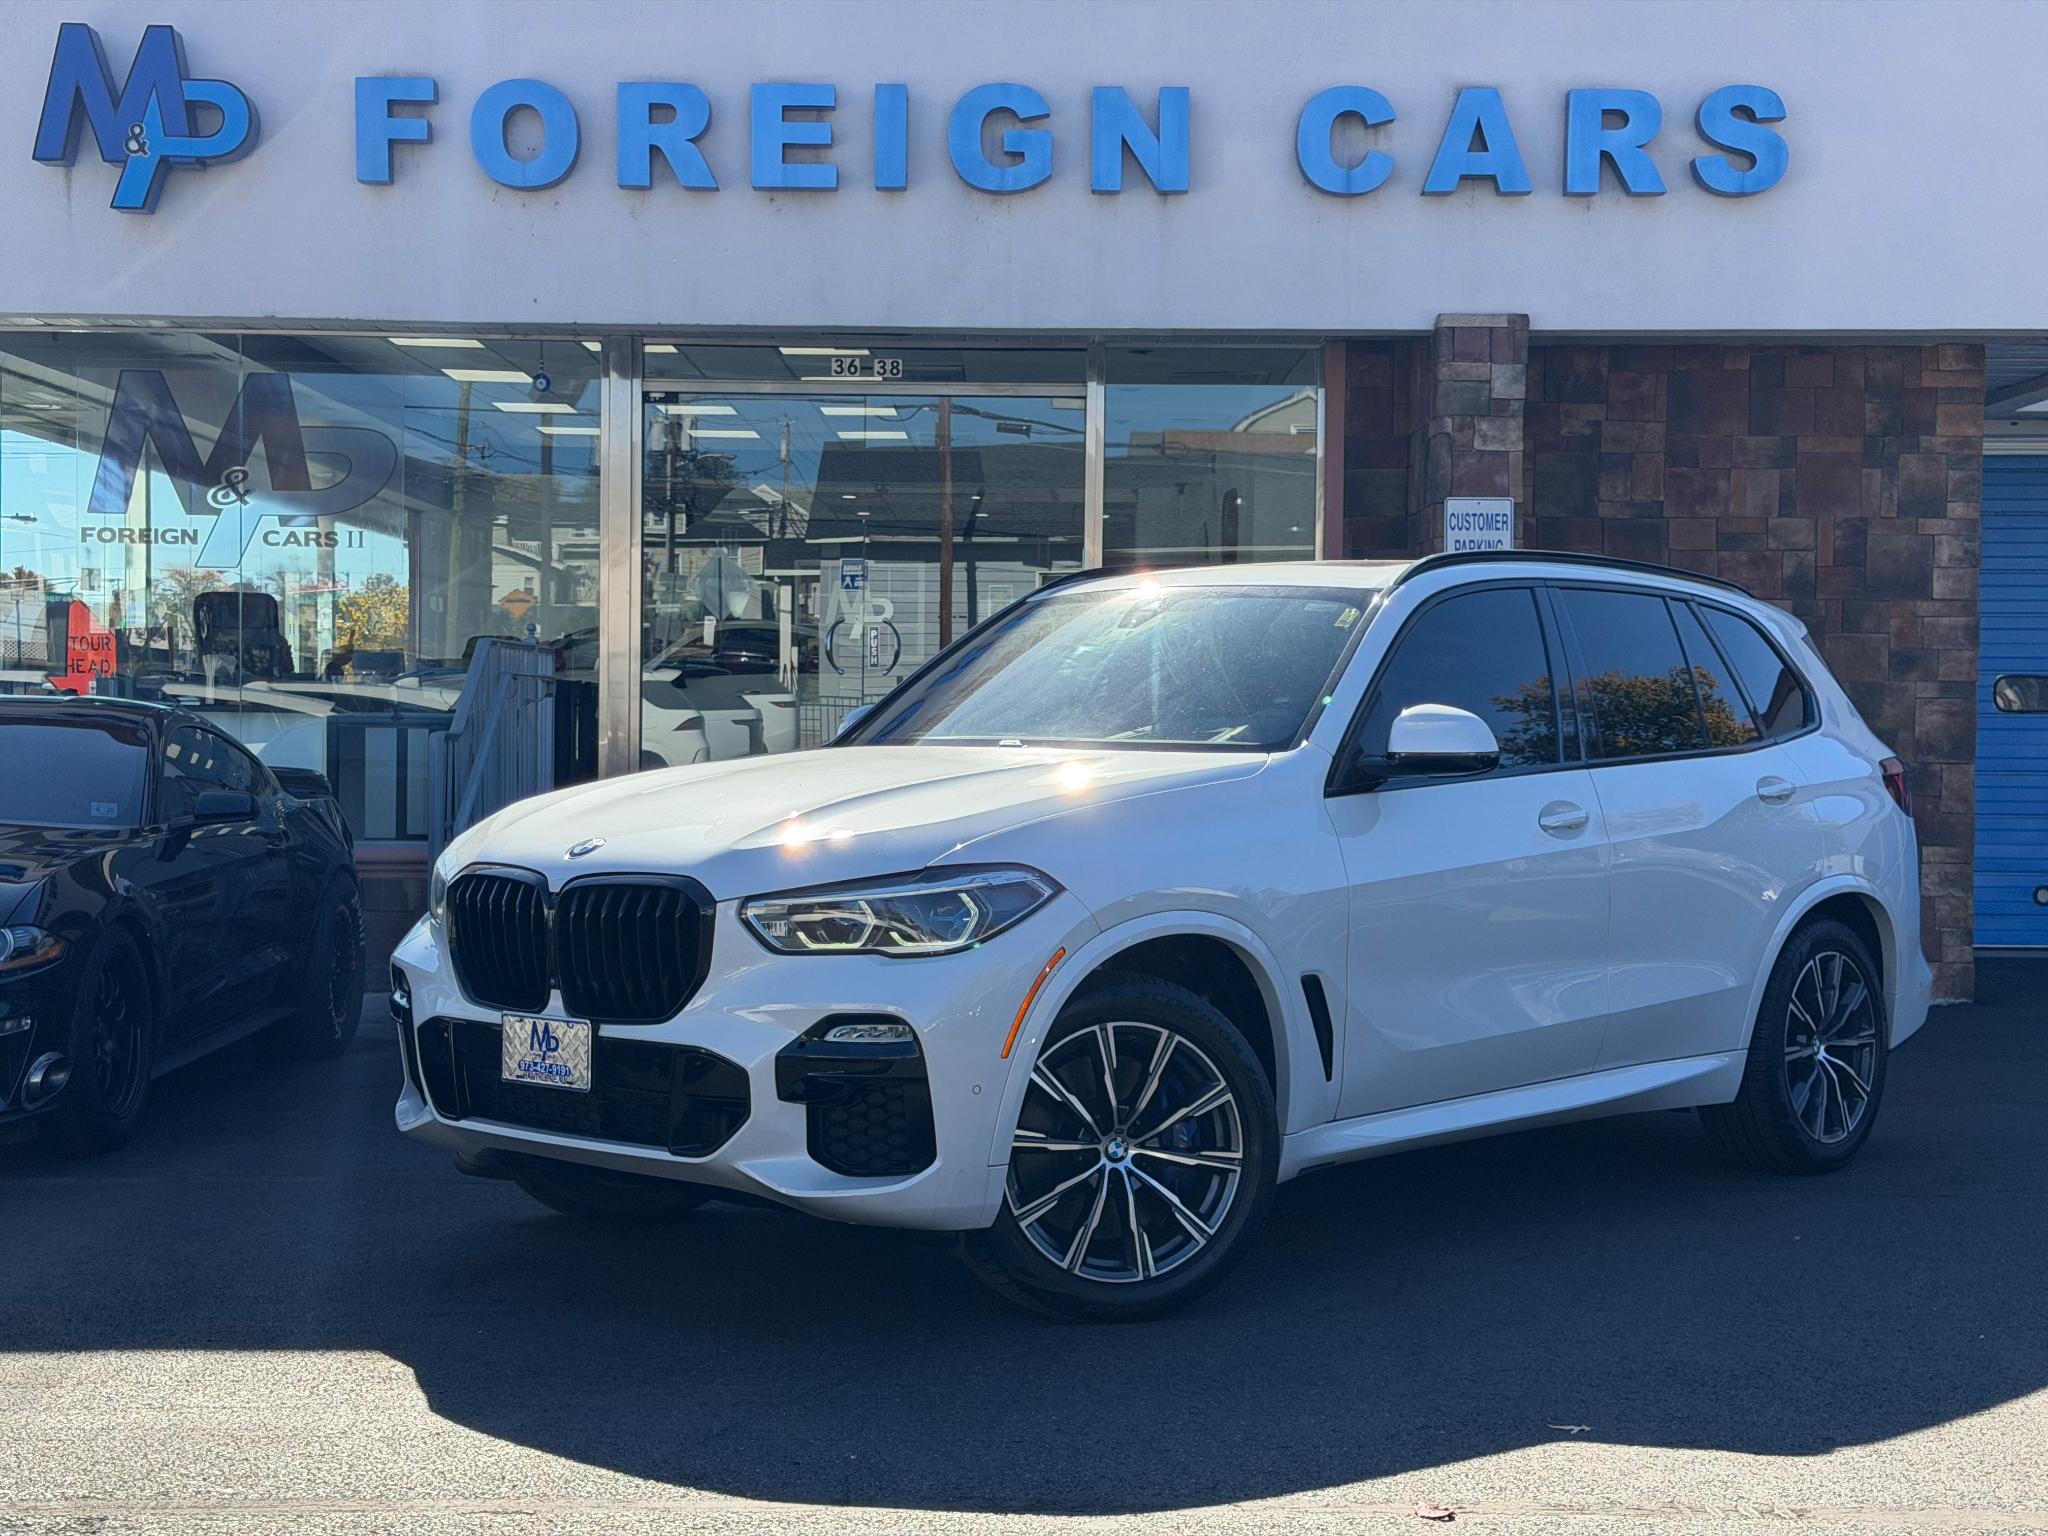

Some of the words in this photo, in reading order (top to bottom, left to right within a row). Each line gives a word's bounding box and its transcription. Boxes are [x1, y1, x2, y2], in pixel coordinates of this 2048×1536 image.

[354, 76, 1191, 196] FOREIGN
[1296, 83, 1790, 198] CARS
[833, 358, 901, 377] 36-38
[1449, 512, 1509, 532] CUSTOMER
[80, 526, 199, 546] FOREIGN
[262, 529, 339, 549] CARS
[69, 636, 112, 652] TOUR
[870, 628, 878, 665] PUSH
